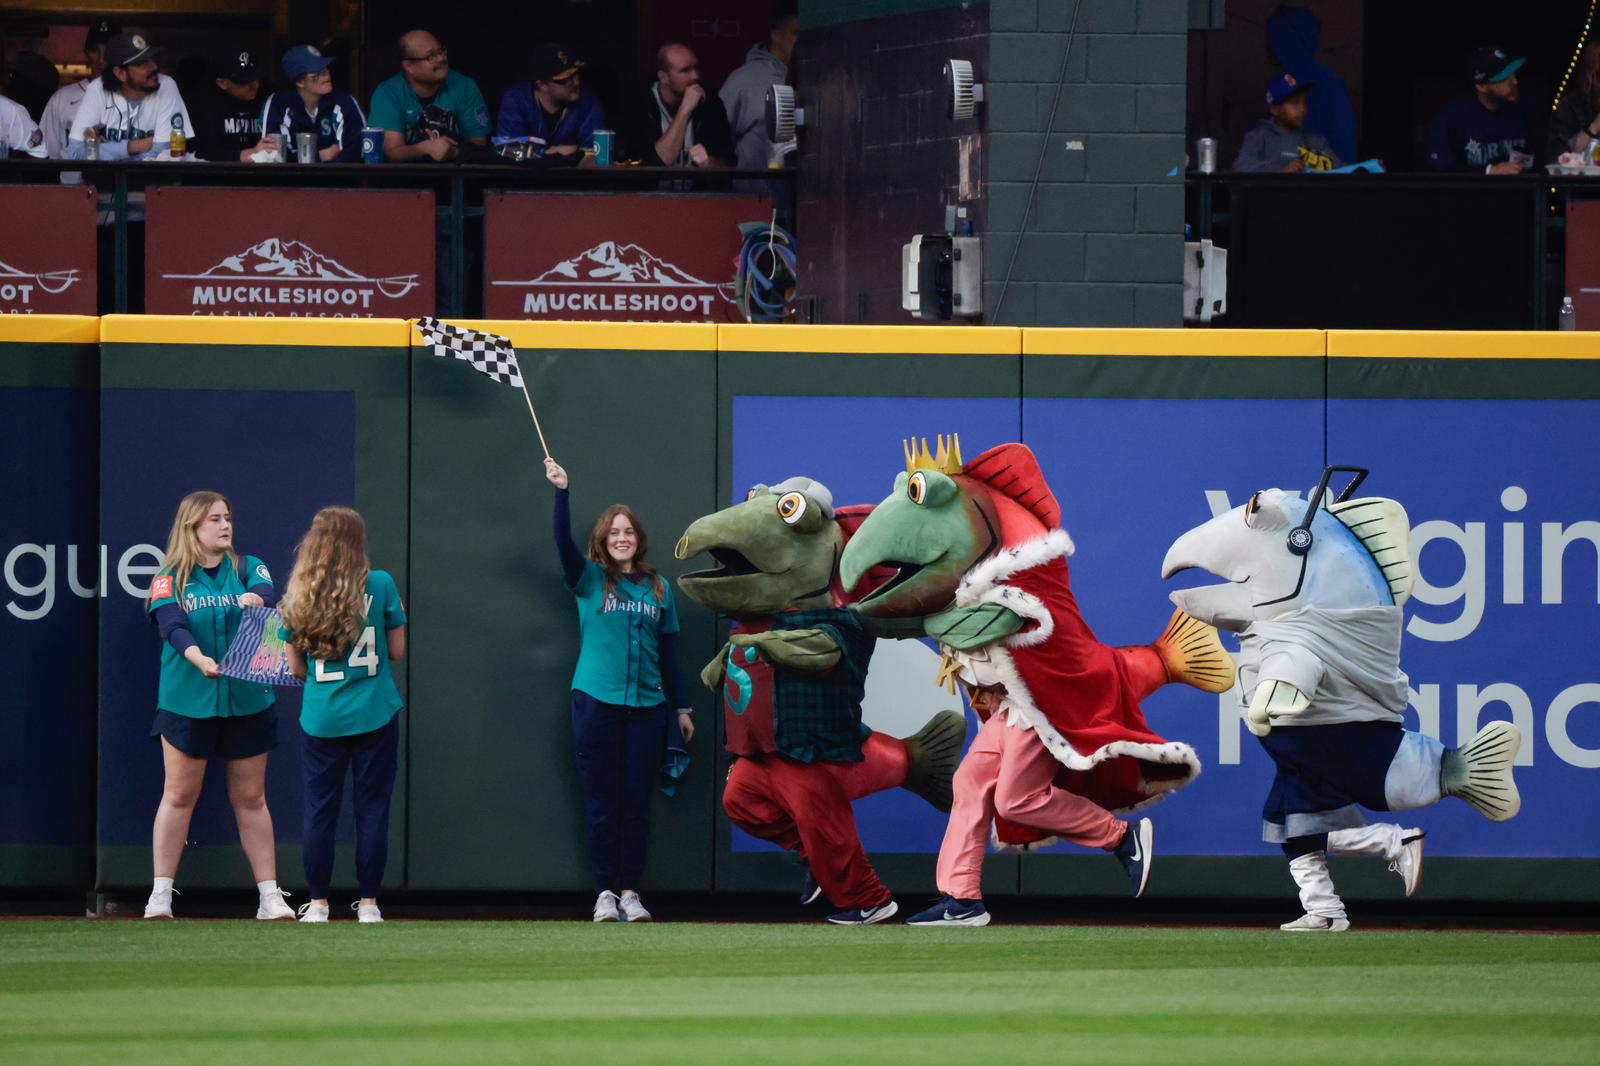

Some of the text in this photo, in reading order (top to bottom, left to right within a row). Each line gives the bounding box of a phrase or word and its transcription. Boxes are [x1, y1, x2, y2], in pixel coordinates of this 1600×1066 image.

[192, 286, 374, 308] MUCKLESHOOT
[523, 293, 714, 315] MUCKLESHOOT
[604, 598, 661, 622] MARINE
